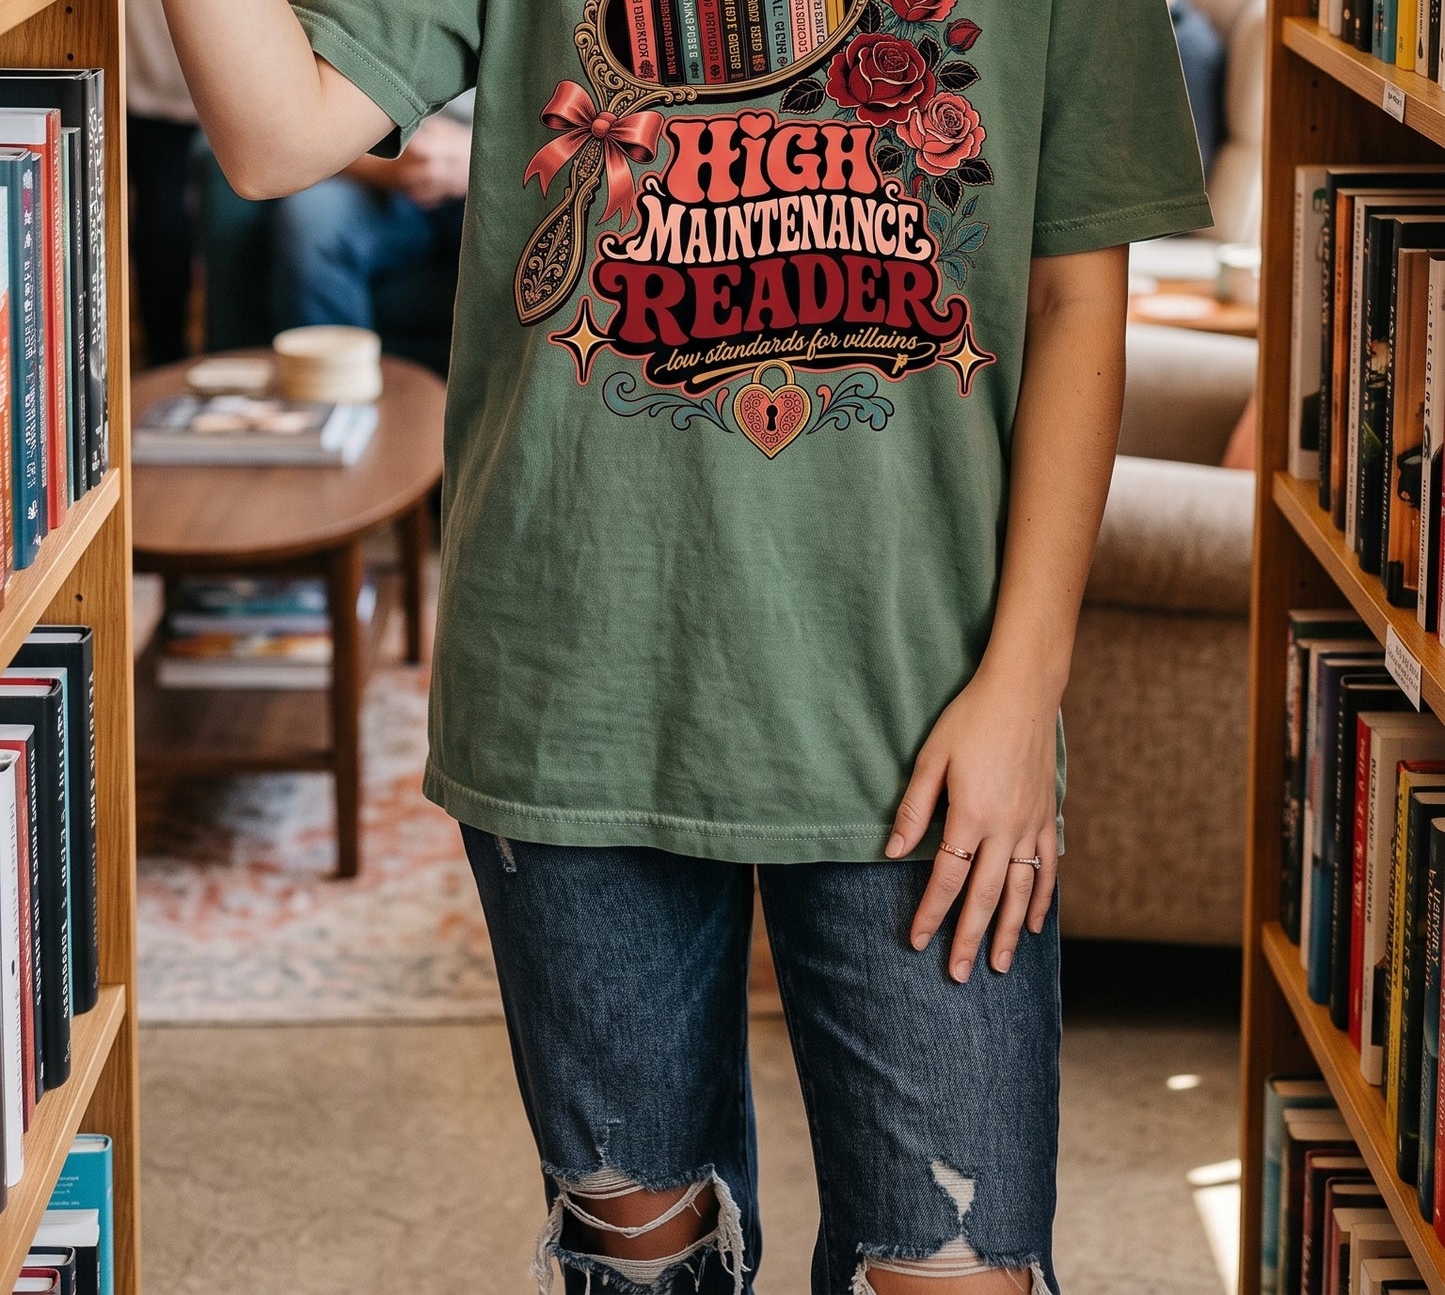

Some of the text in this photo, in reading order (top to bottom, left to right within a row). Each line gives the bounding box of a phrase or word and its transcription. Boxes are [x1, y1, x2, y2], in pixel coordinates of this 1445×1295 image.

[603, 181, 931, 264] MAINTENANCE
[599, 254, 967, 346] READER
[658, 327, 918, 372] low standards for villains
